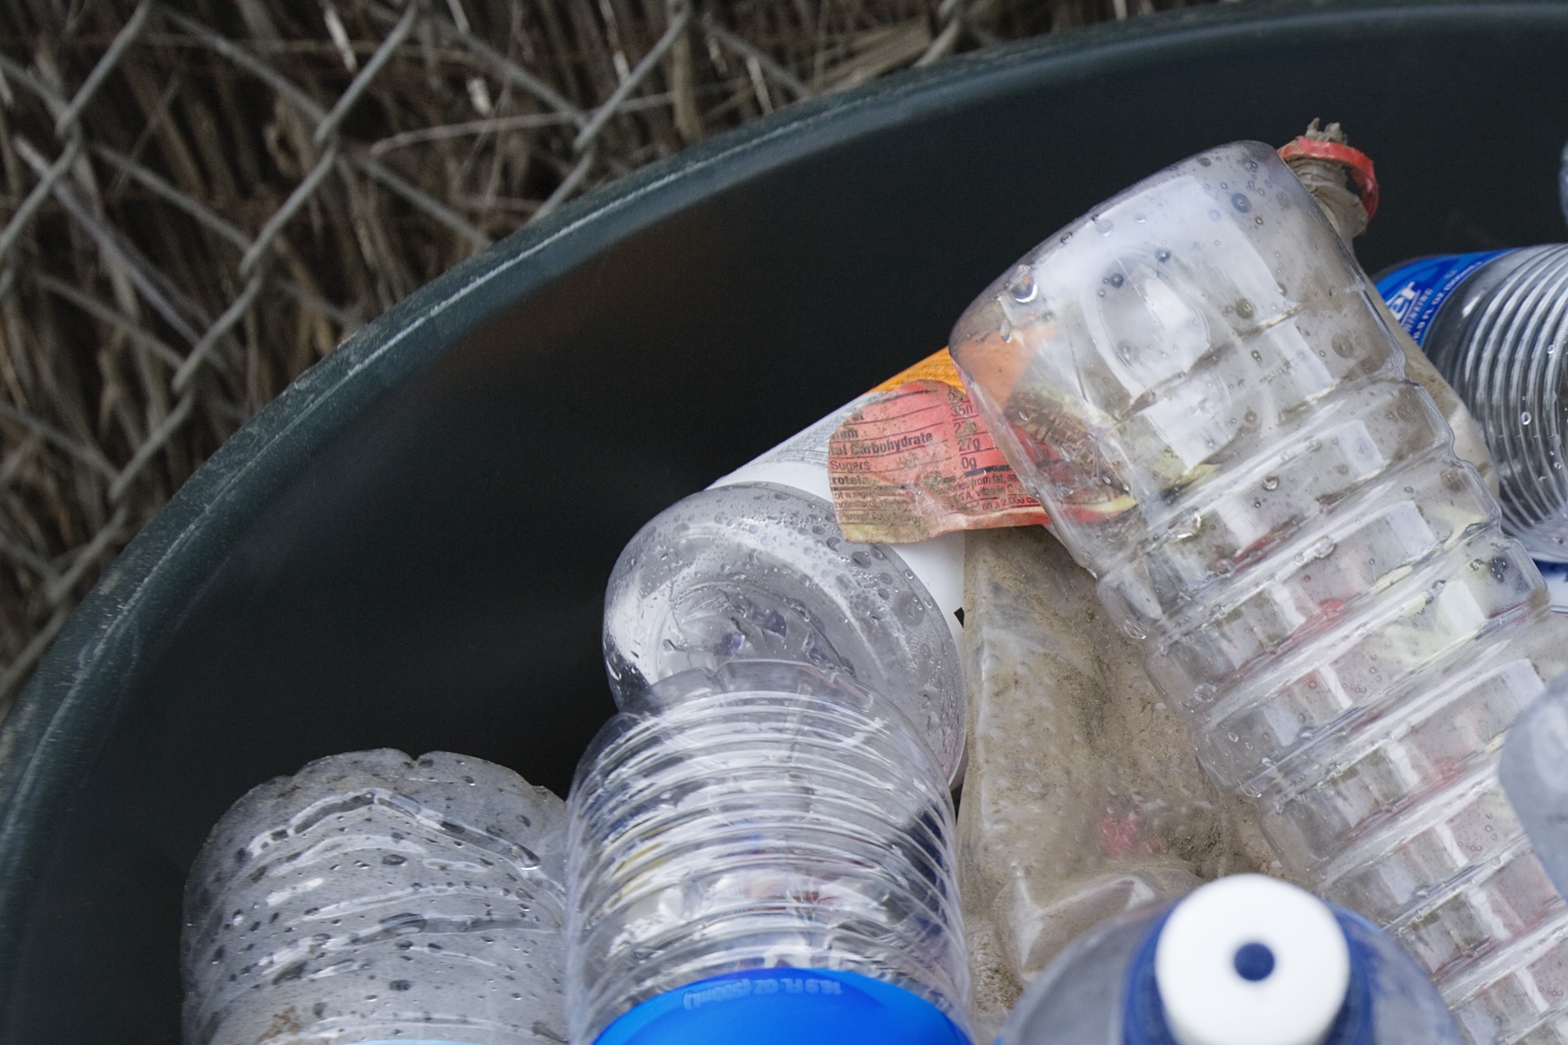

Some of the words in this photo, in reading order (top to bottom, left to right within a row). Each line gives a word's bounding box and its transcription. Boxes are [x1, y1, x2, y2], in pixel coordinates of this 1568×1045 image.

[830, 460, 871, 473] Sugars
[957, 437, 981, 452] 27g
[850, 431, 933, 456] Carbohydrate
[961, 457, 977, 471] 0g
